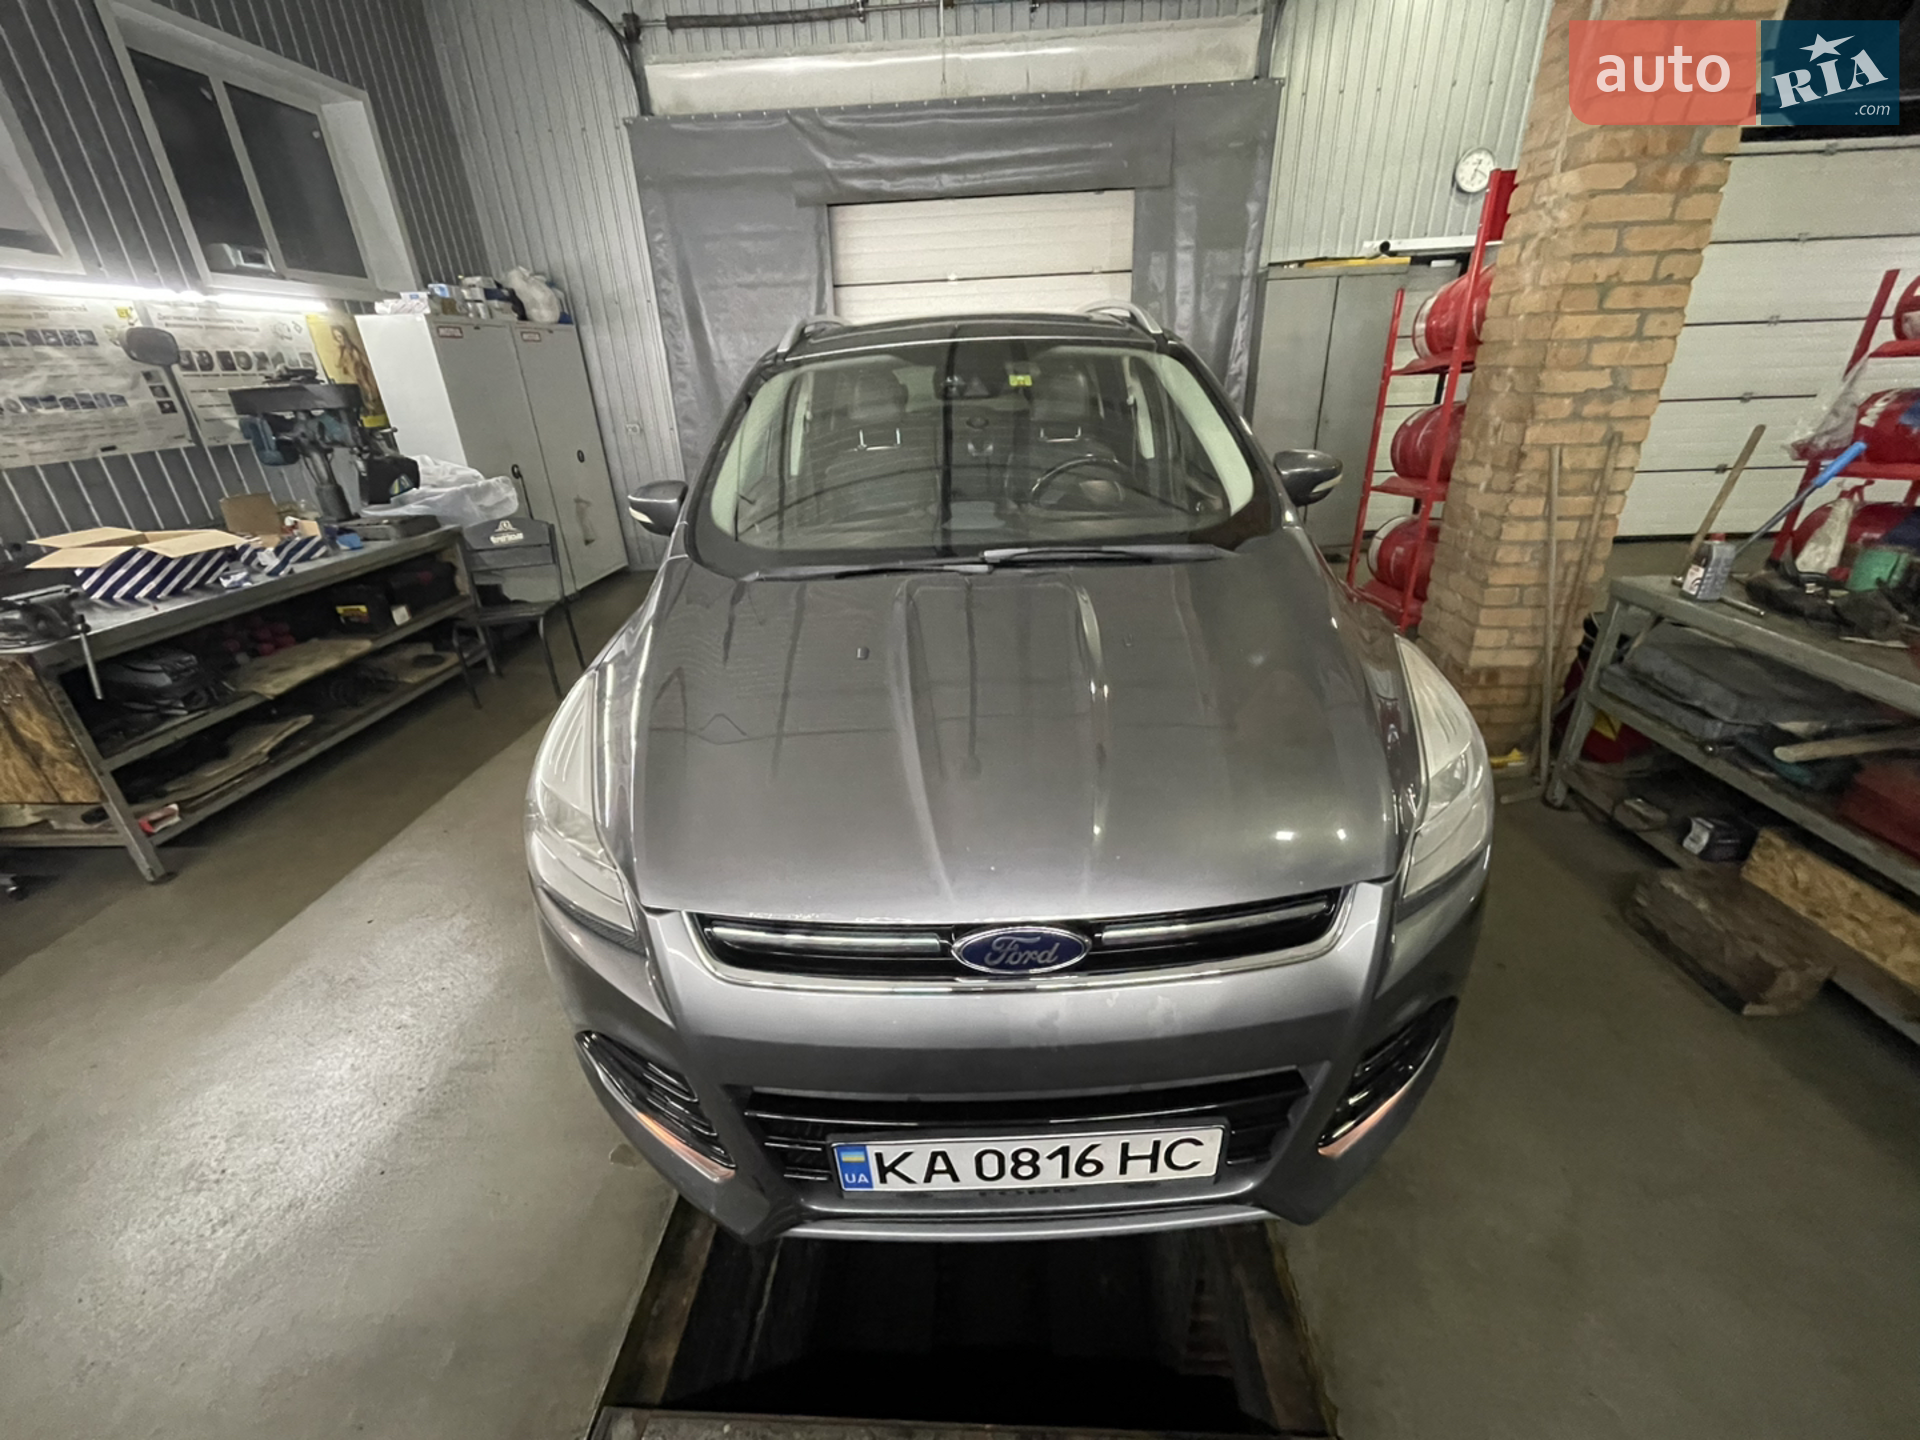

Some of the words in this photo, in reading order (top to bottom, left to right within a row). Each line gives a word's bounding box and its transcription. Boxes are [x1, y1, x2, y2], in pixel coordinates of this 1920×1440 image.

[984, 936, 1060, 966] Ford
[874, 1150, 960, 1184] KA
[974, 1143, 1104, 1181] 0816
[1119, 1137, 1204, 1176] HC
[844, 1173, 869, 1184] UA
